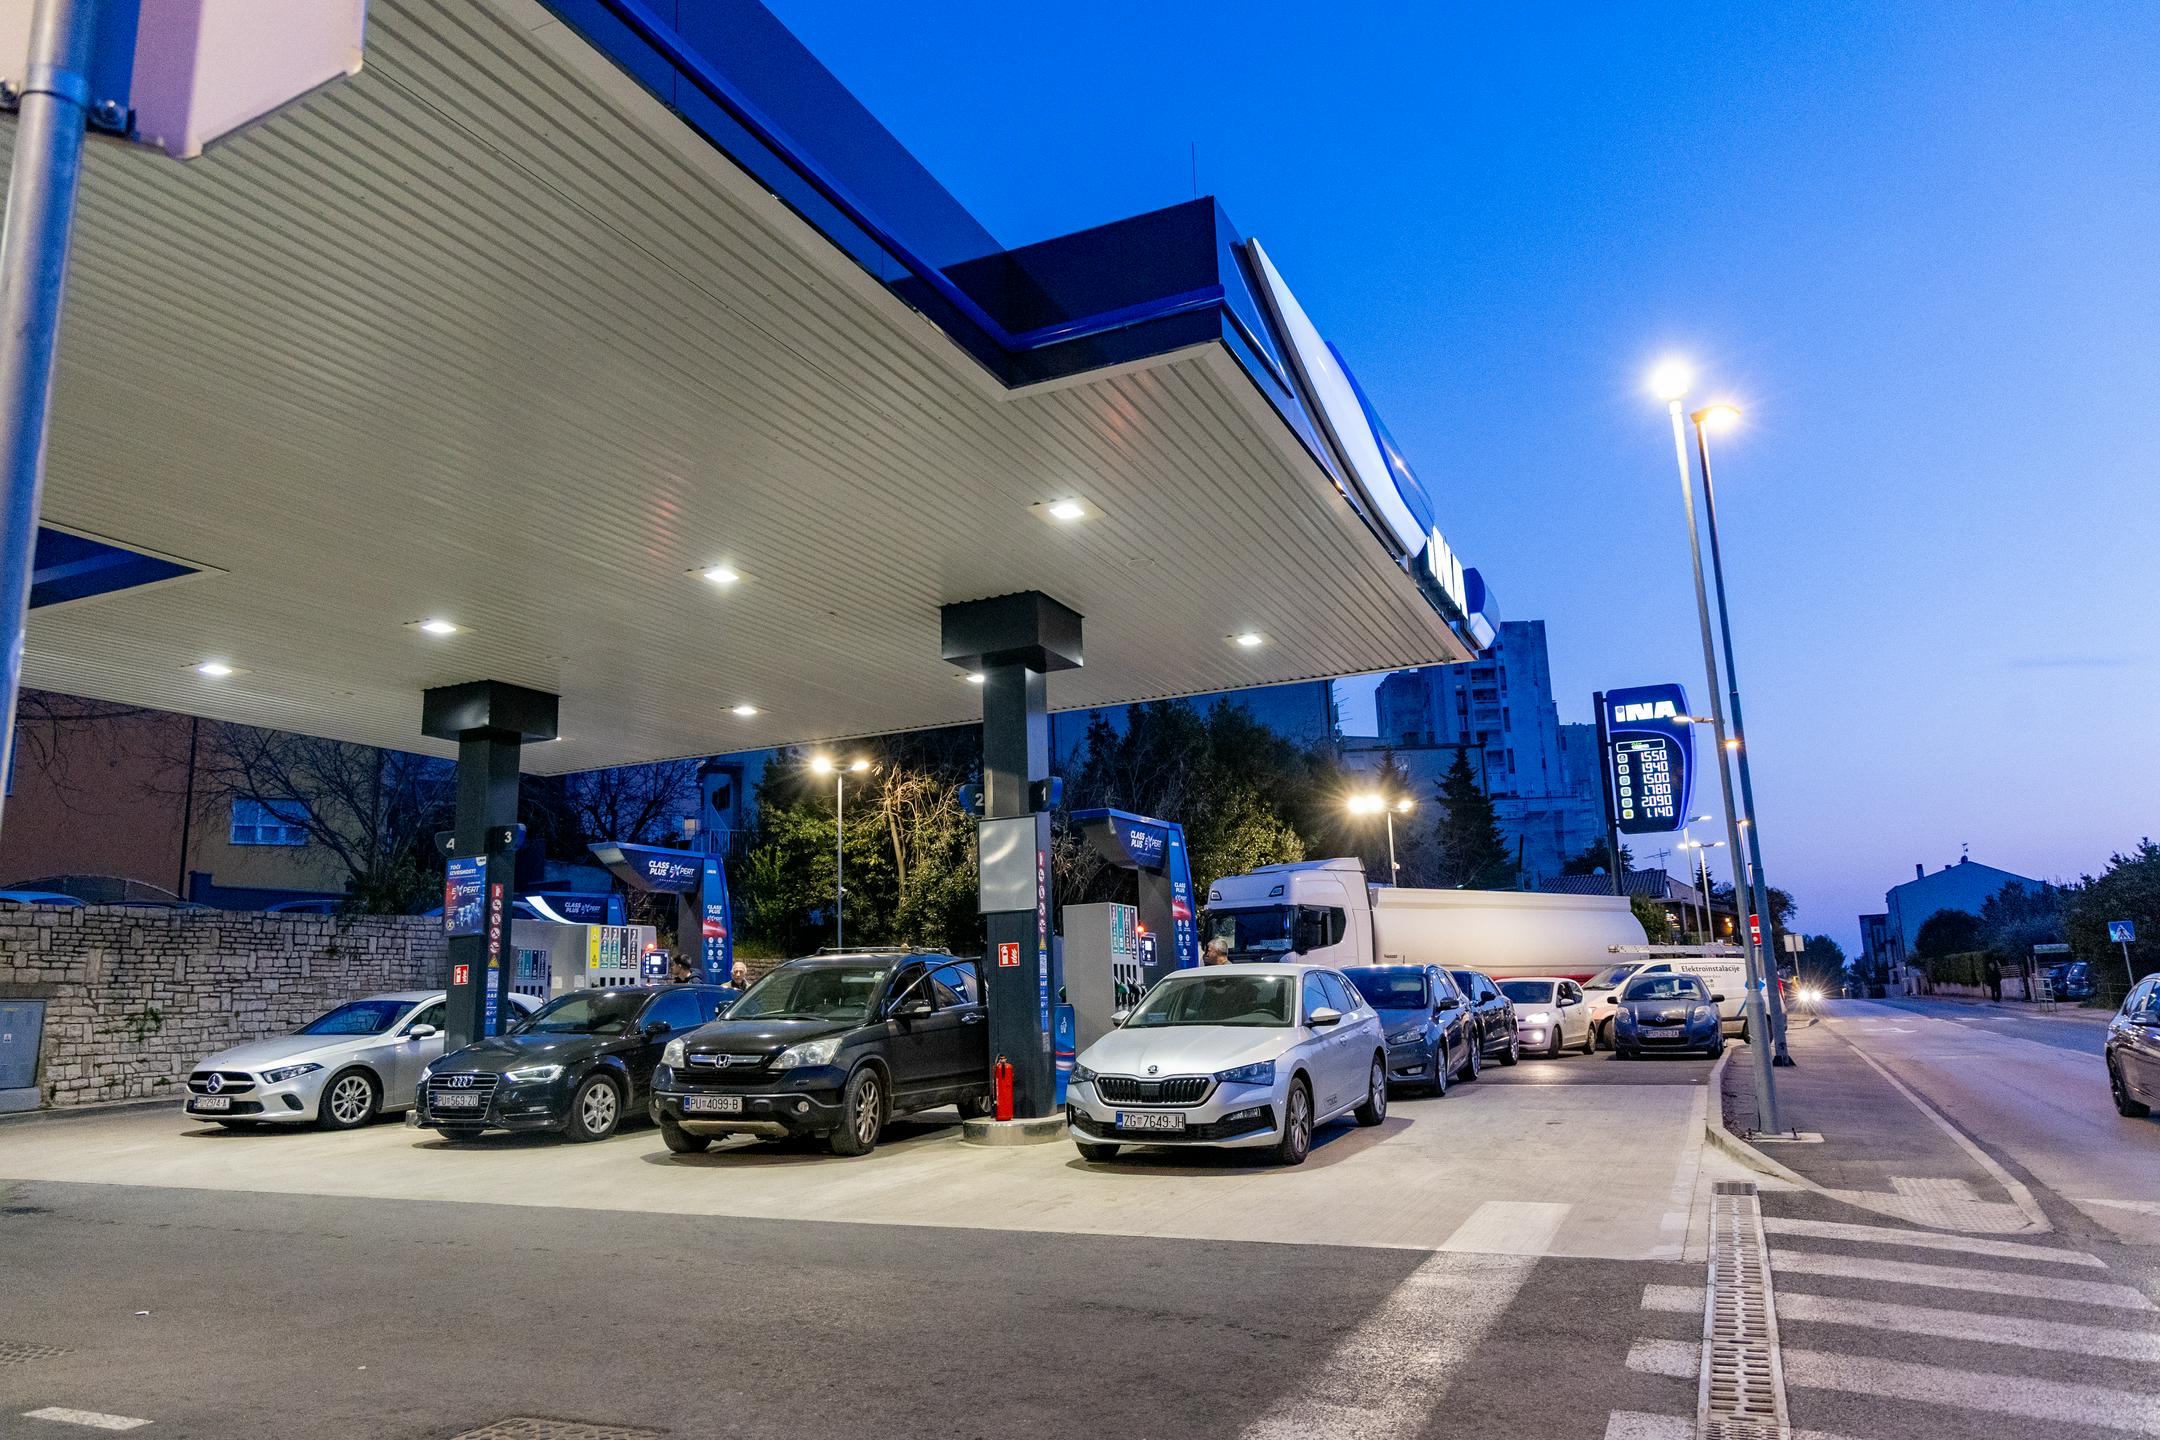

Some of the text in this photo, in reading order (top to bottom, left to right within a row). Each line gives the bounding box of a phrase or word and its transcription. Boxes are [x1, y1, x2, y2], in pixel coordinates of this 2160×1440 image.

[1615, 701, 1677, 722] INA
[1041, 787, 1047, 801] 1
[975, 793, 984, 807] 2
[504, 831, 512, 843] 3
[1130, 830, 1145, 840] CLASS
[446, 838, 455, 850] 4
[1131, 839, 1143, 848] PLUS
[648, 860, 670, 869] CLASS
[649, 868, 667, 876] PLUS
[1681, 965, 1740, 973] Elektroinstalacije
[439, 1096, 447, 1106] PU
[691, 1098, 702, 1109] PU
[1124, 1115, 1136, 1127] ZG
